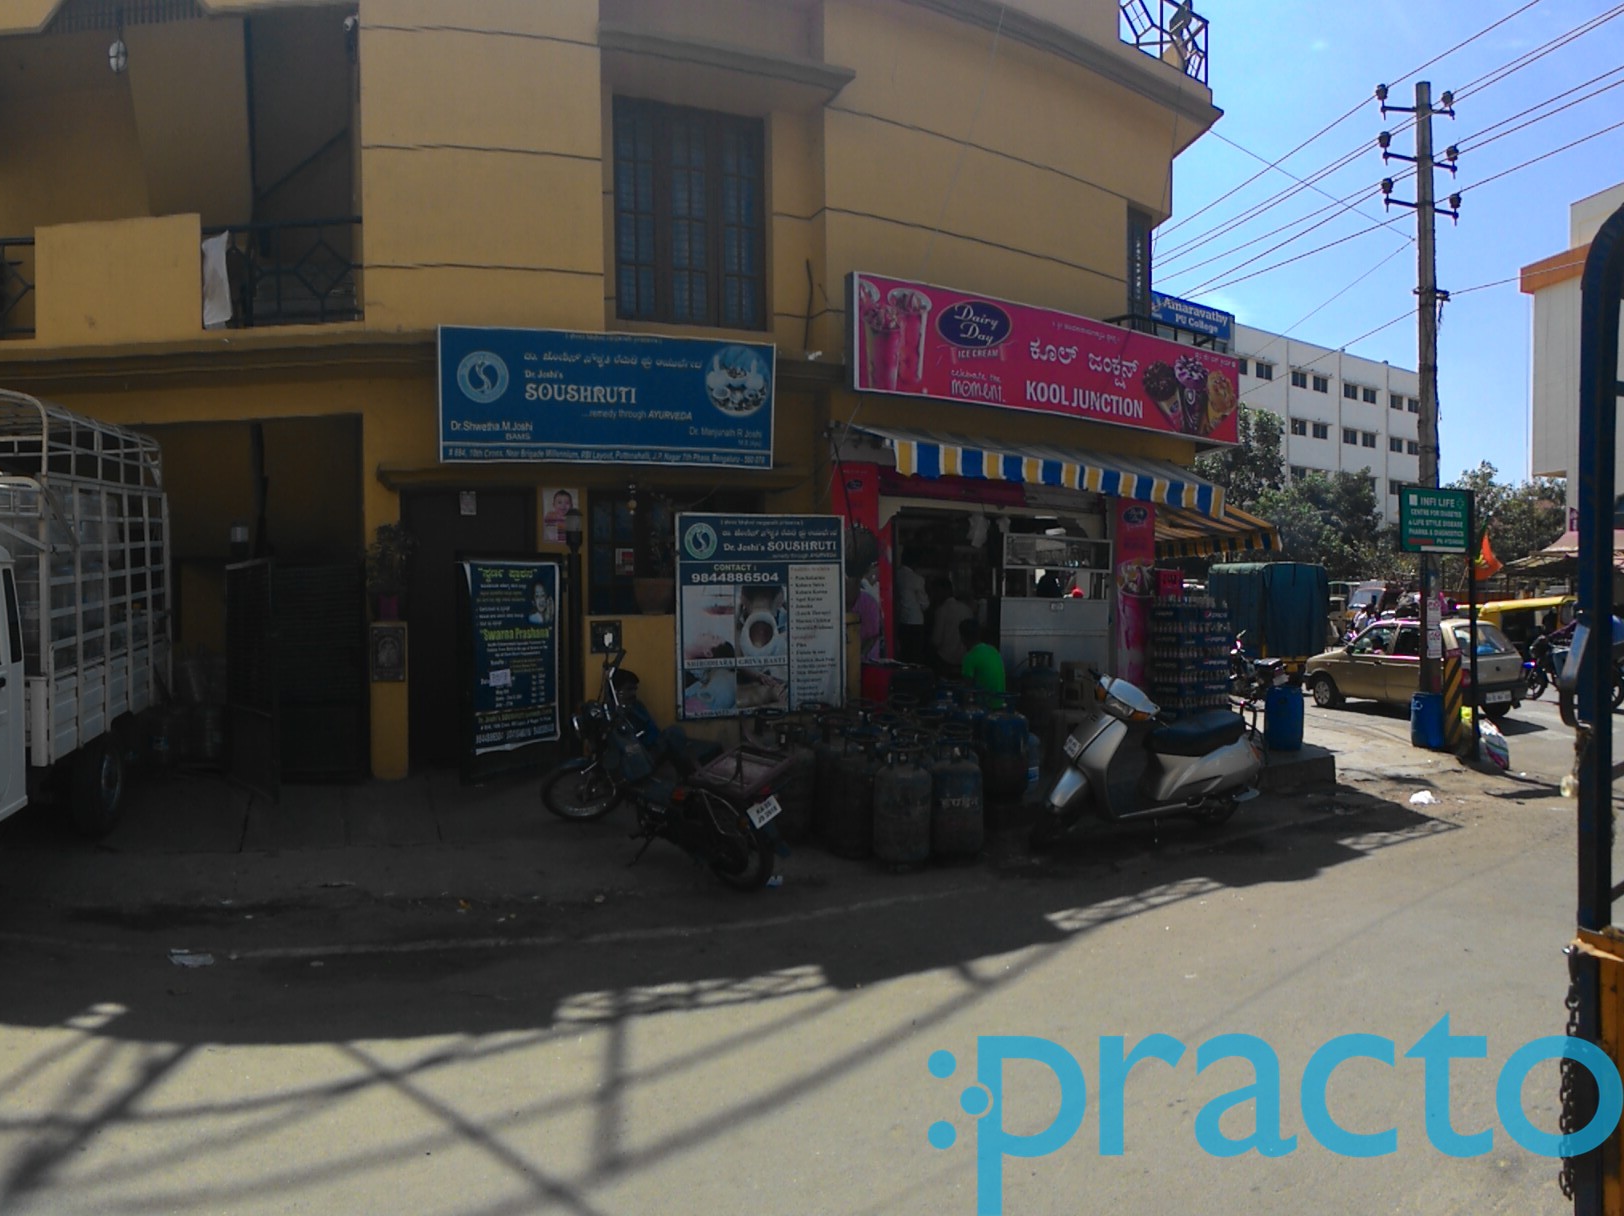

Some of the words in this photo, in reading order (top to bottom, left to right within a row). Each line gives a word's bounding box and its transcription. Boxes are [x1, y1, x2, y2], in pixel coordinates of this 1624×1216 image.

[954, 303, 1000, 331] Dairy
[1162, 297, 1229, 327] Amaravathy
[960, 321, 994, 346] Day
[958, 349, 971, 358] ICE
[972, 349, 999, 359] CREAM
[1030, 337, 1080, 365] ಕೂಲ್
[1089, 352, 1140, 389] ಜಂಕ್ಷನ್
[525, 383, 636, 404] SOUSHRUTI
[1026, 380, 1070, 406] KOOL
[1072, 387, 1144, 419] JUNCTION
[1420, 496, 1436, 506] INFI
[1438, 498, 1455, 508] LIFE
[767, 540, 836, 552] SOUSHRUTI
[691, 572, 779, 584] 9844886504
[713, 564, 751, 572] CONTACT
